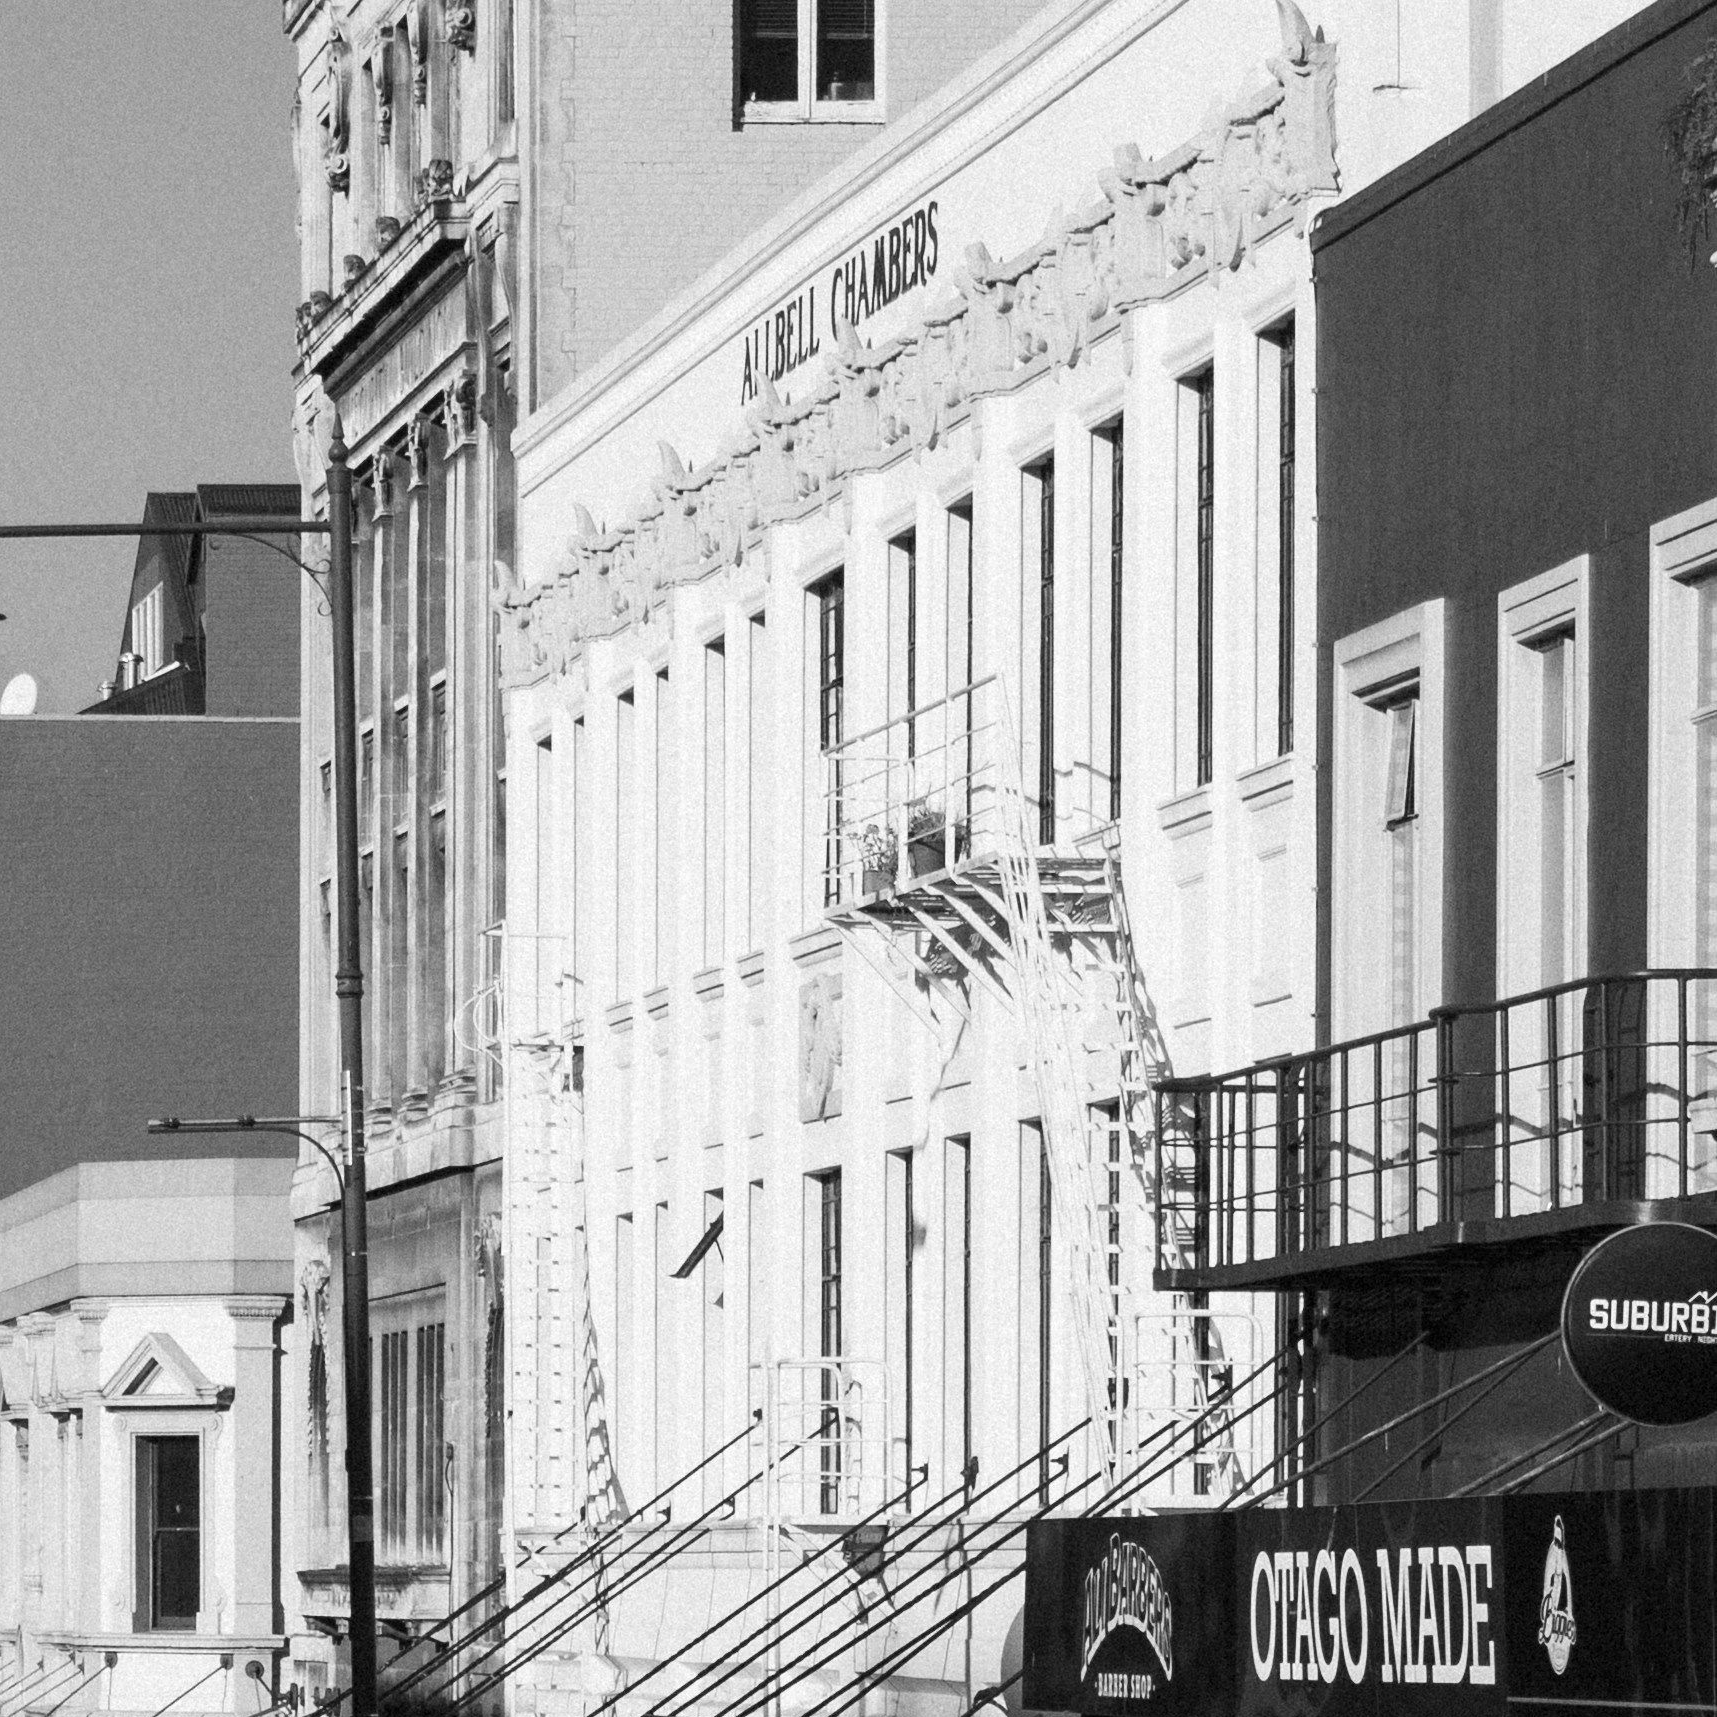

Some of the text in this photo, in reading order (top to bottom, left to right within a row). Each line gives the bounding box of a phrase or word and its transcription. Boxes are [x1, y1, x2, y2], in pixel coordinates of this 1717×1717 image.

[831, 201, 938, 341] CHAMBERS
[1250, 1544, 1495, 1686] OTAGO MADE
[1097, 1672, 1153, 1699] BARBER SHOP
